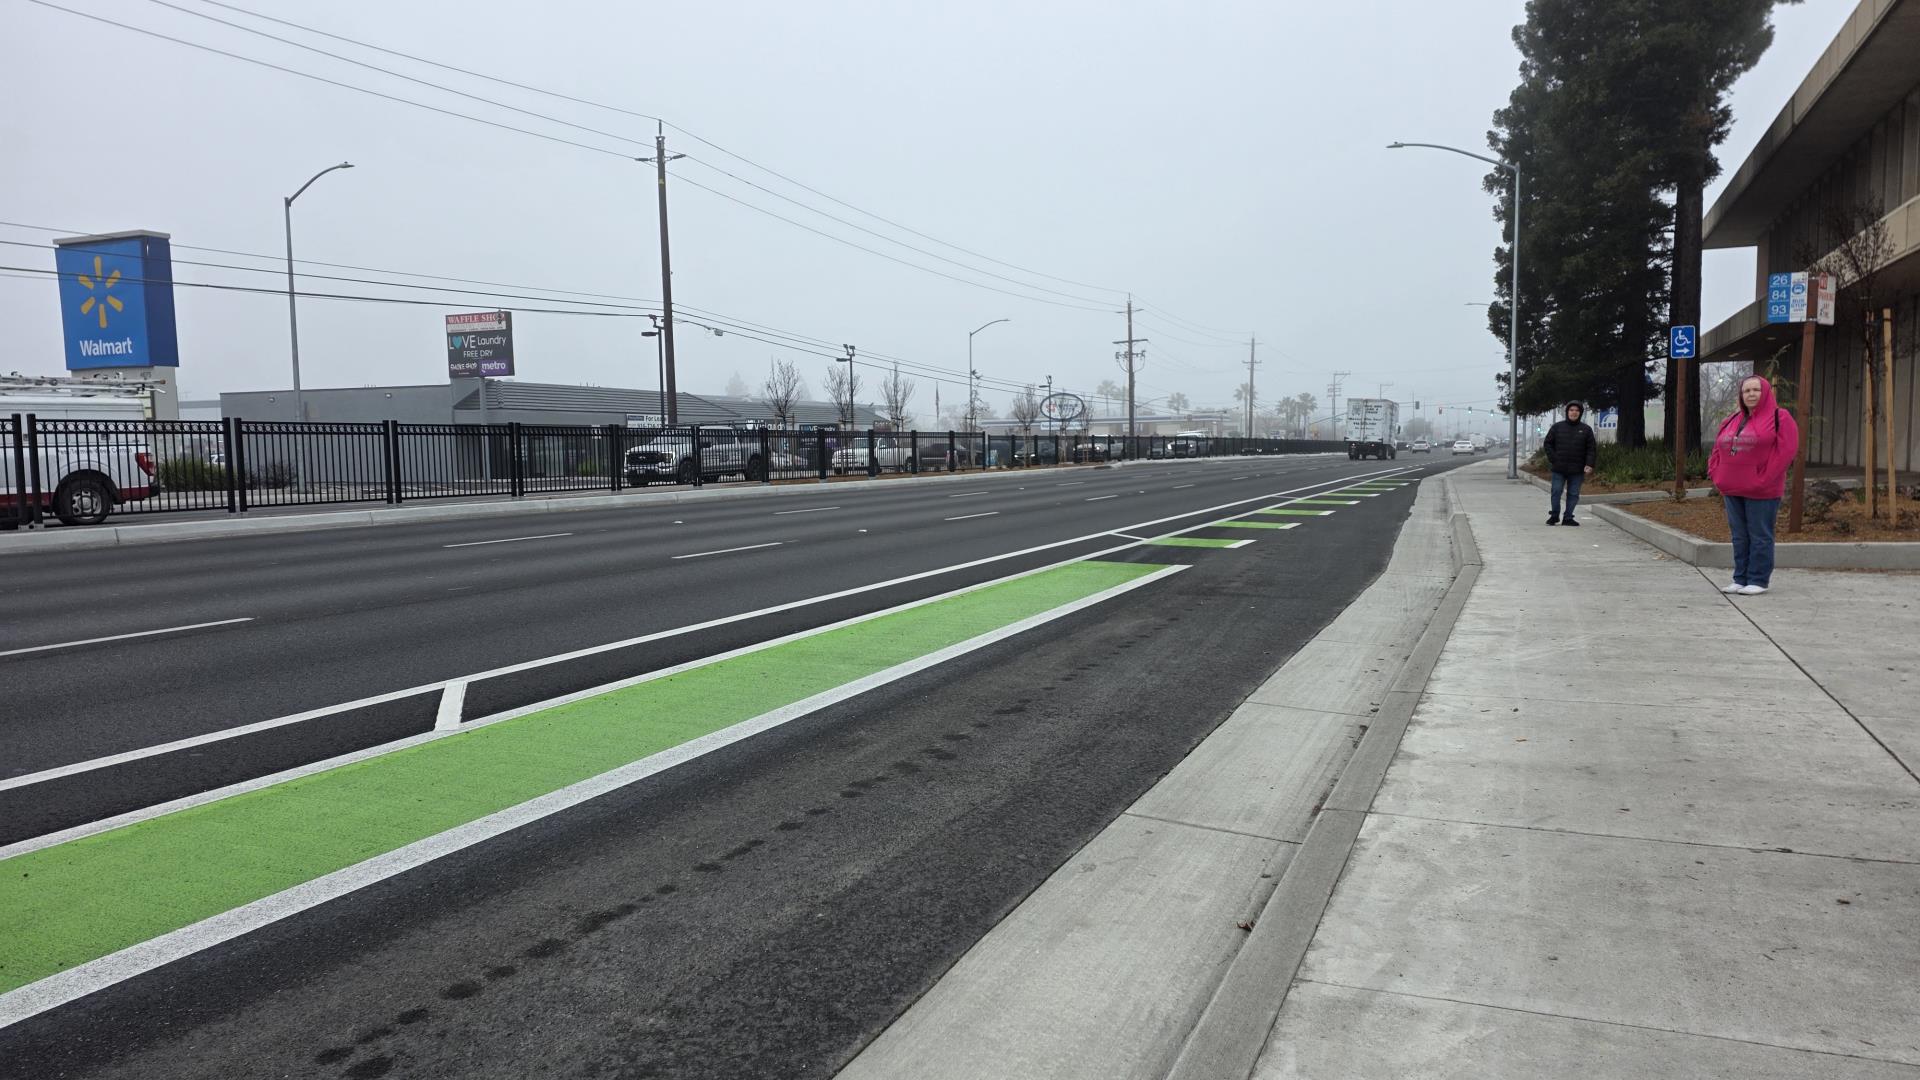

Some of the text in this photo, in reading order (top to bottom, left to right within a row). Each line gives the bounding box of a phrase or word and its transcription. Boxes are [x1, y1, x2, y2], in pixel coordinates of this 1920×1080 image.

[1772, 275, 1788, 286] 26
[1771, 289, 1787, 300] 84
[1771, 305, 1787, 315] 93
[448, 314, 479, 324] WAFFLE
[79, 337, 133, 357] Walmart
[448, 335, 506, 350] LVE Laundry
[463, 349, 494, 358] FREE DRY
[481, 361, 506, 370] metro
